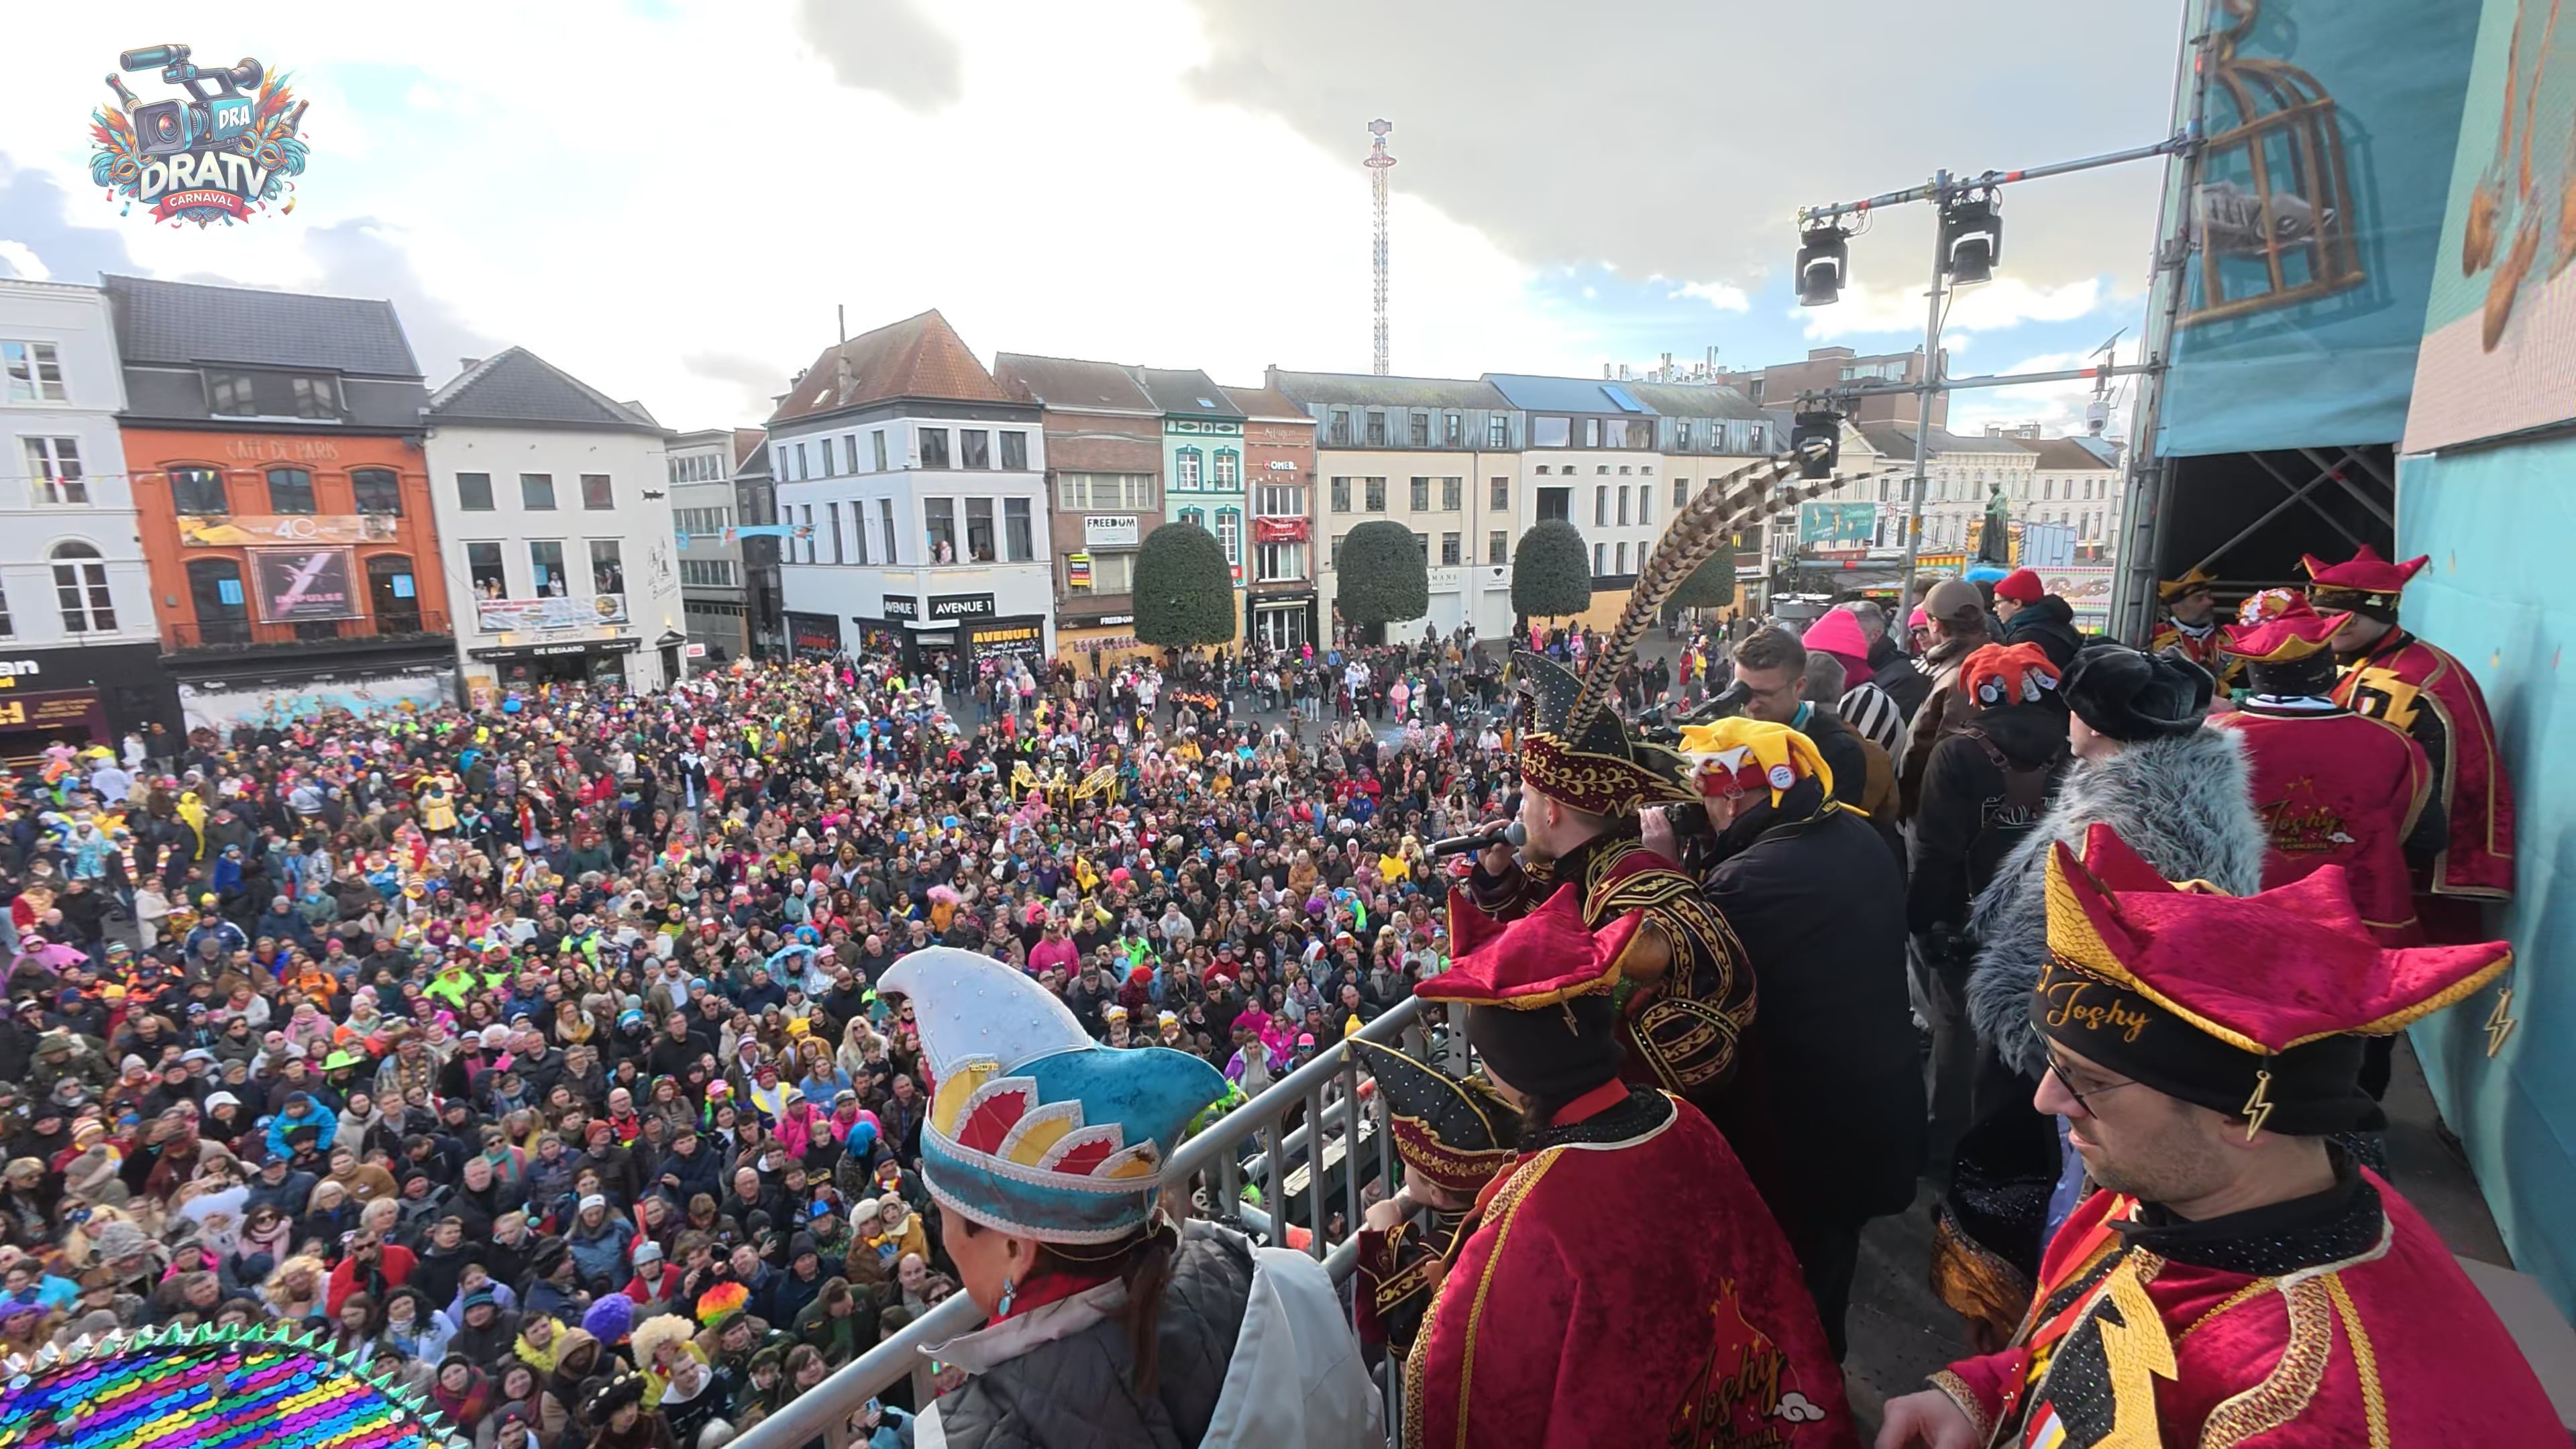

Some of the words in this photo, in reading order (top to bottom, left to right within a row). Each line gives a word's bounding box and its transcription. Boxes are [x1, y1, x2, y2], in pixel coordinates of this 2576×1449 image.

[295, 440, 338, 460] PARIS
[1087, 518, 1136, 528] FREEDOM
[884, 601, 912, 614] AVENUE
[912, 604, 917, 614] 1
[936, 602, 983, 614] AVENUE
[986, 600, 991, 611] 1
[973, 629, 1031, 643] AVENUE
[1032, 627, 1039, 637] 1
[2046, 981, 2152, 1042] Joshy
